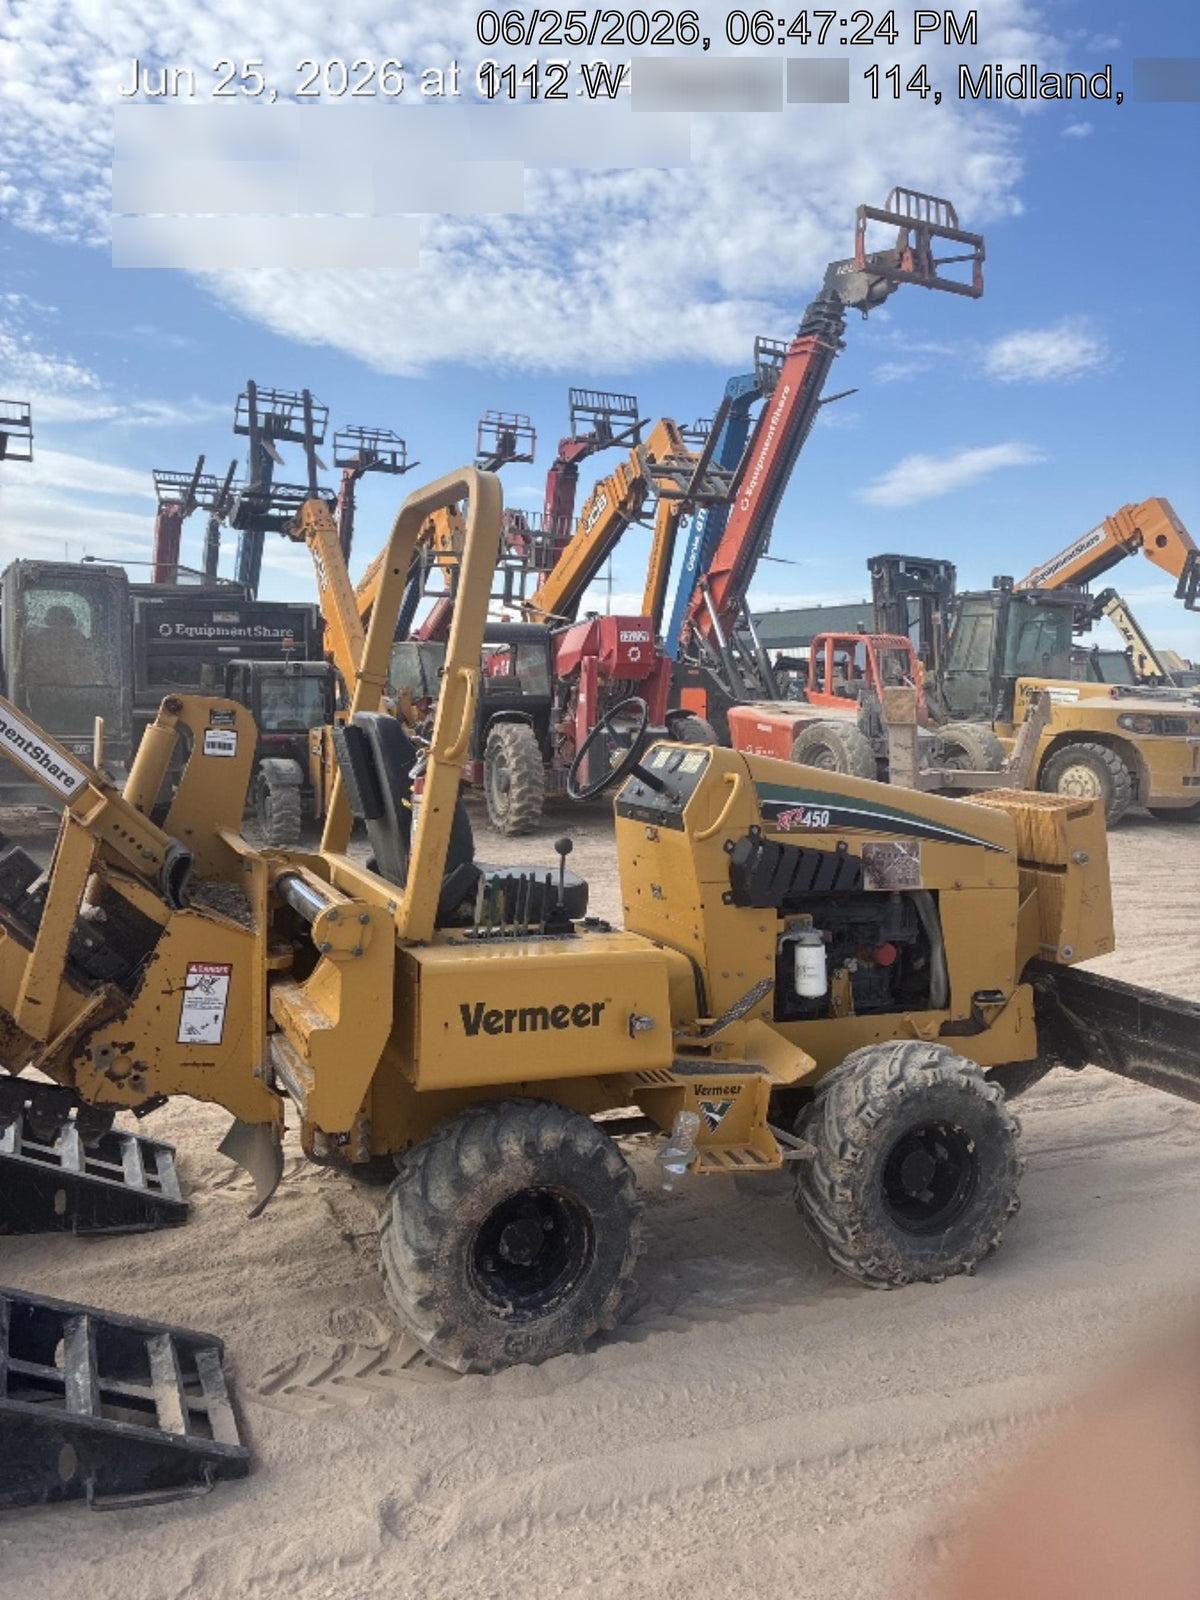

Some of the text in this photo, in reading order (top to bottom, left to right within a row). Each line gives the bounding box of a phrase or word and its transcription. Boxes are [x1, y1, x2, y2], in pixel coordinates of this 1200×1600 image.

[175, 623, 294, 638] EquipmentShare
[459, 1002, 605, 1036] Vermeer
[694, 1084, 741, 1096] Vermeer
